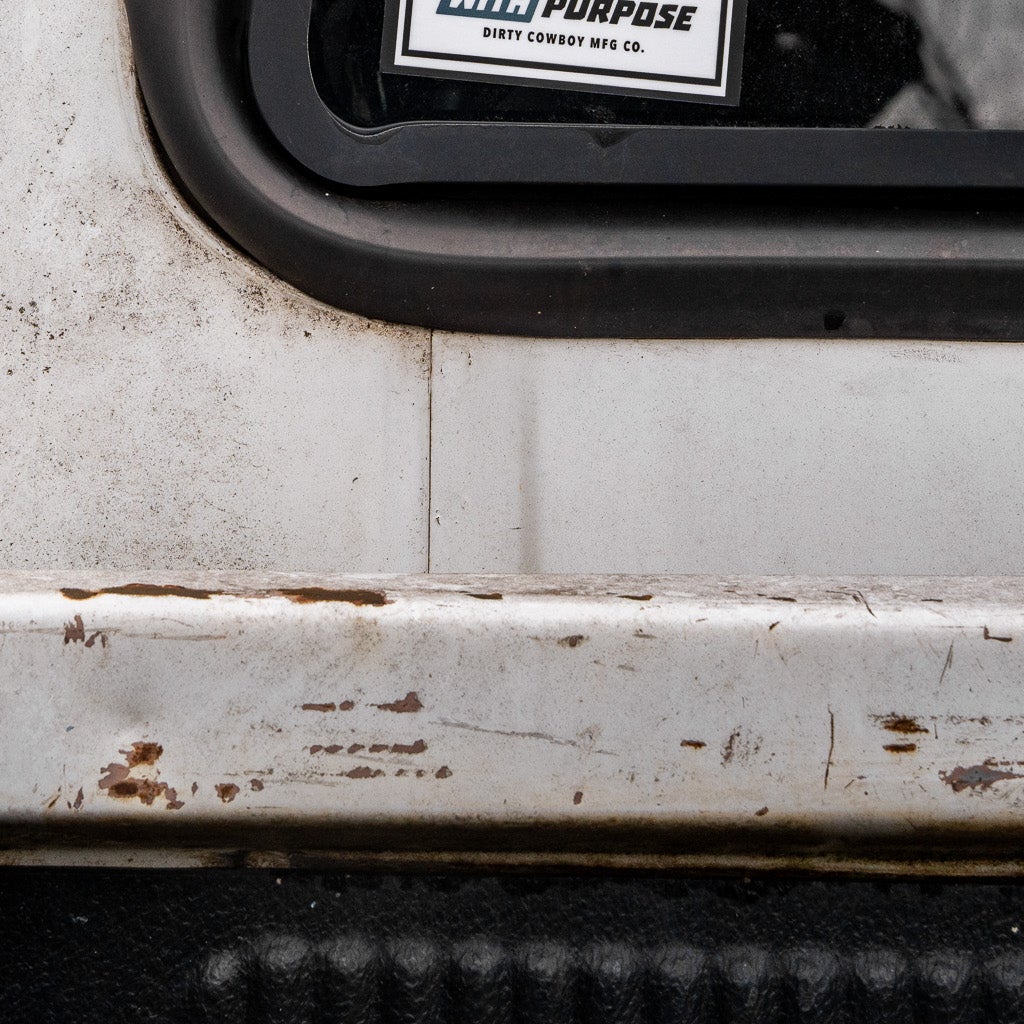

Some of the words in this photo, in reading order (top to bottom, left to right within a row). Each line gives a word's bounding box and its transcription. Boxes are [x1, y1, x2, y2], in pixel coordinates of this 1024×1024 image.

[483, 27, 523, 42] DIRTY
[527, 31, 585, 48] COWBOY
[590, 36, 618, 52] MFG
[624, 41, 645, 54] CO.
